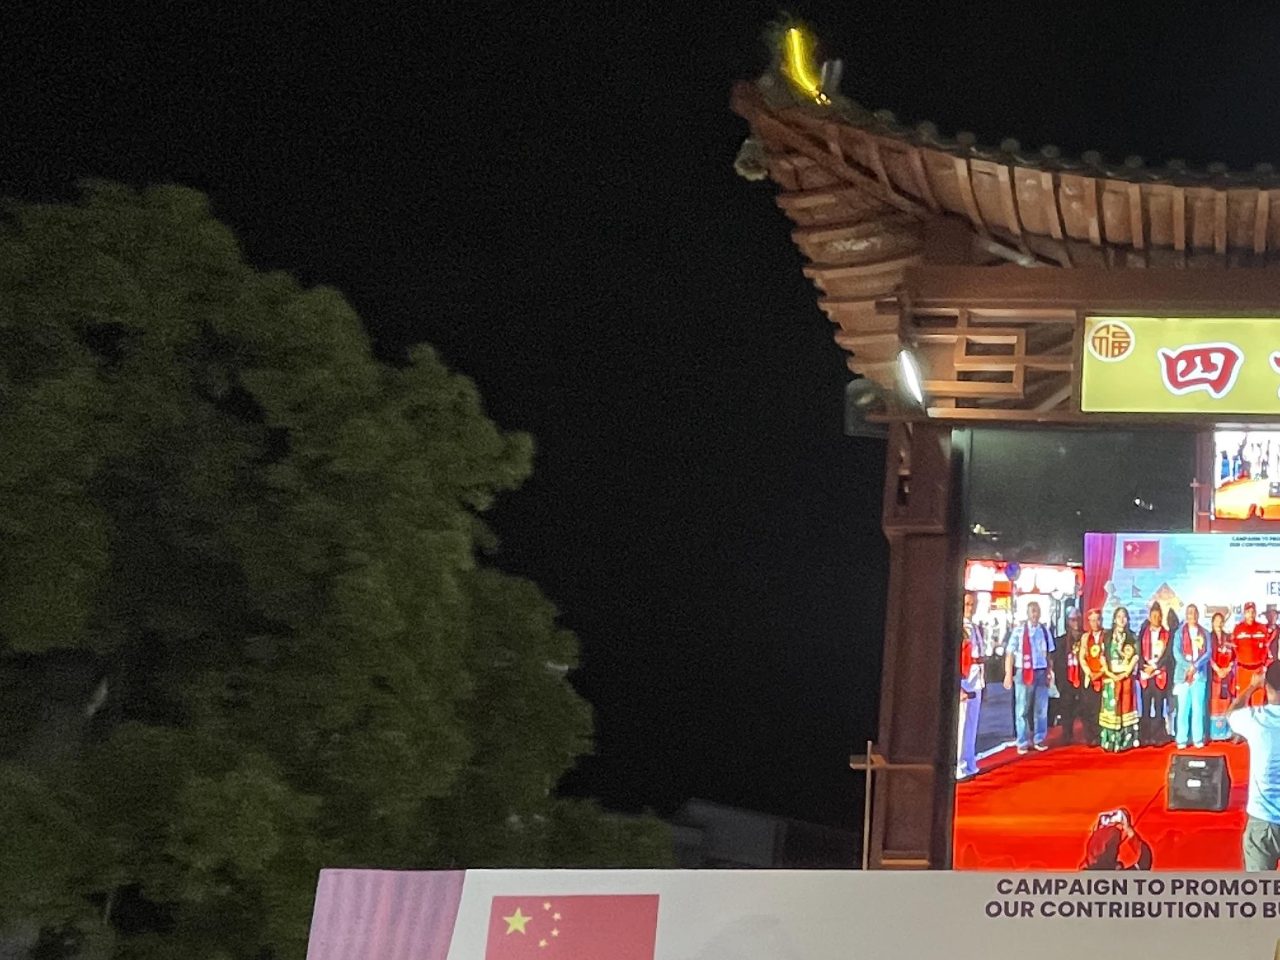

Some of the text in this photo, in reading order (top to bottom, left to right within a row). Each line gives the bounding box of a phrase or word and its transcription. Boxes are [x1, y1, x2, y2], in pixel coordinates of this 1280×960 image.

[997, 878, 1128, 896] CAMPAIGN
[1133, 879, 1165, 896] TO
[985, 901, 1035, 918] OUR
[1040, 901, 1220, 918] CONTRIBUTION
[1225, 901, 1257, 918] TO
